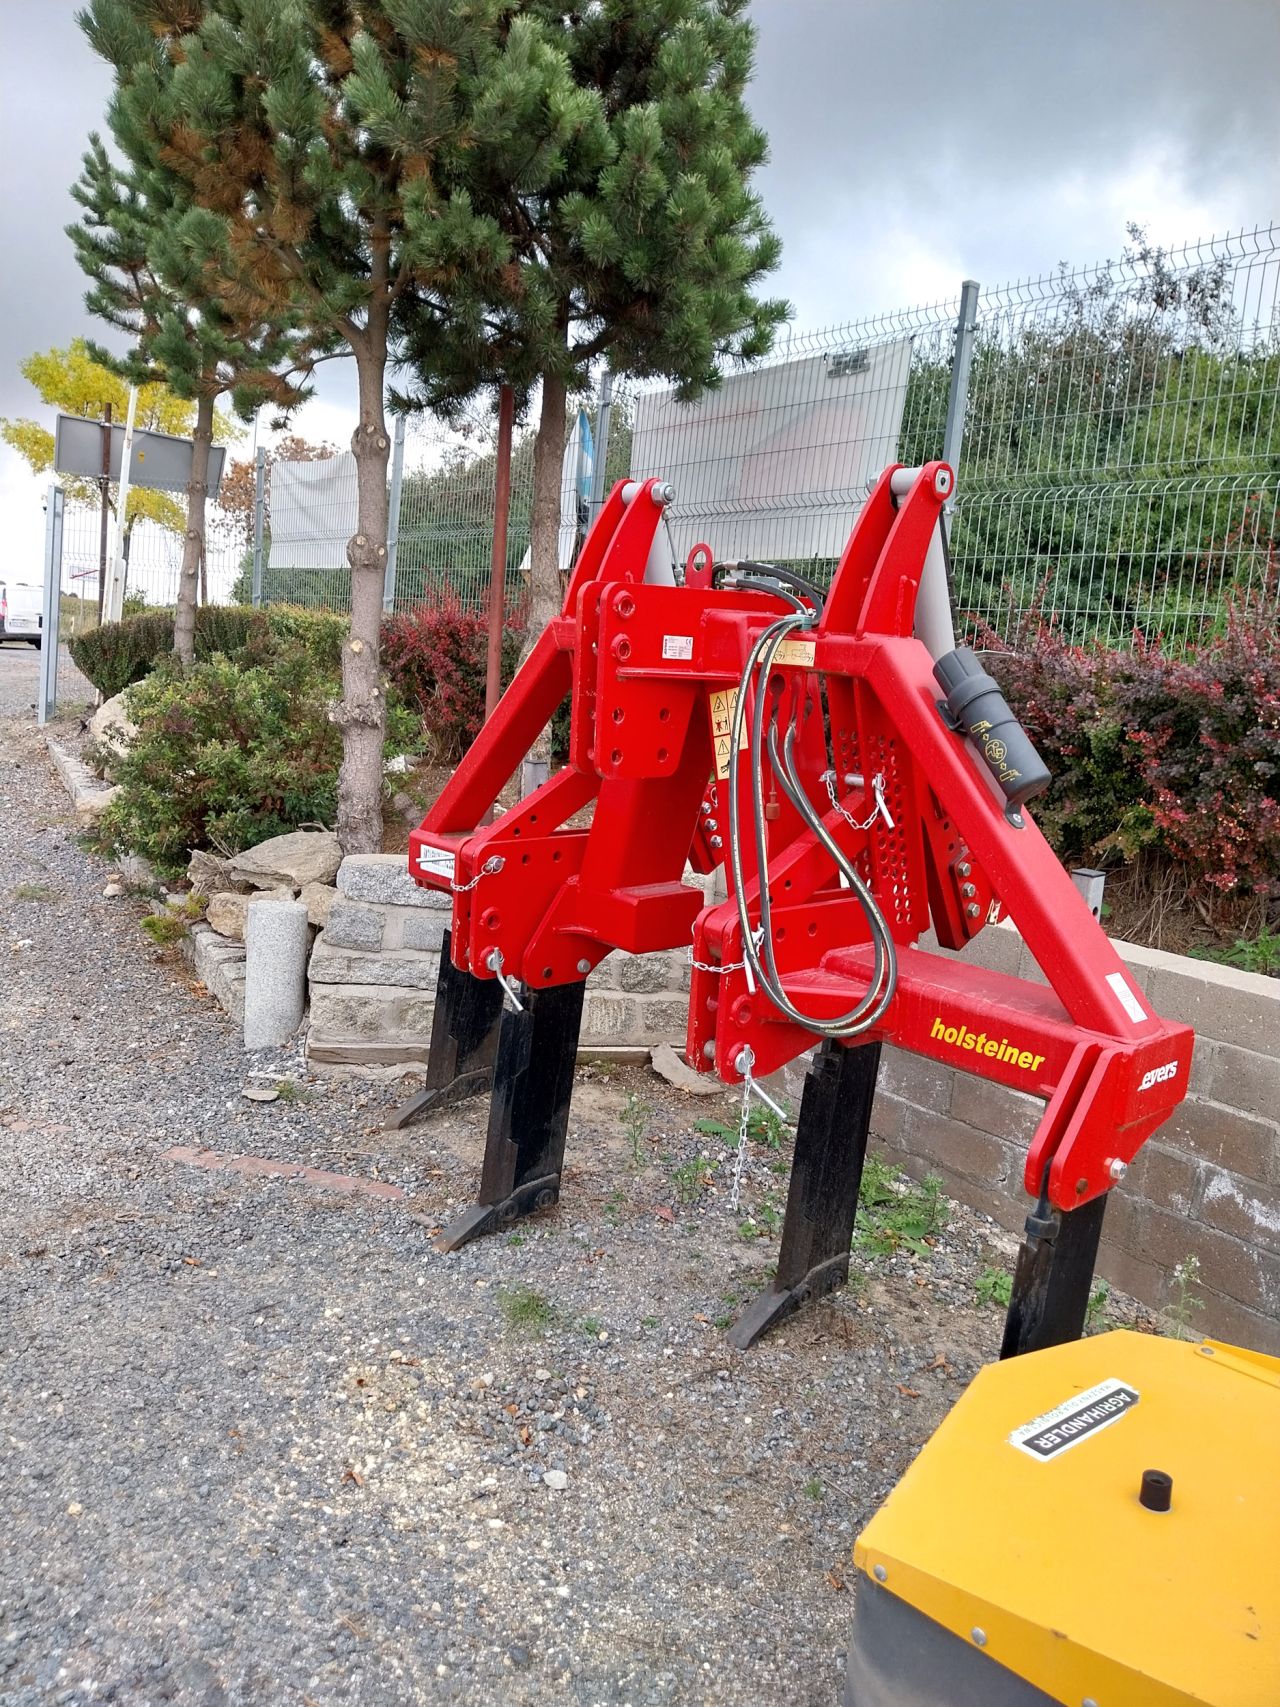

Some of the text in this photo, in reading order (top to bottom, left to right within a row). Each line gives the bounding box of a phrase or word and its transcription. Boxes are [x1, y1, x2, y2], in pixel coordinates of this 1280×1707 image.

[930, 1018, 1046, 1072] holsteiner
[1137, 1060, 1178, 1091] evers
[1033, 1391, 1132, 1449] AGRIHANDLER
